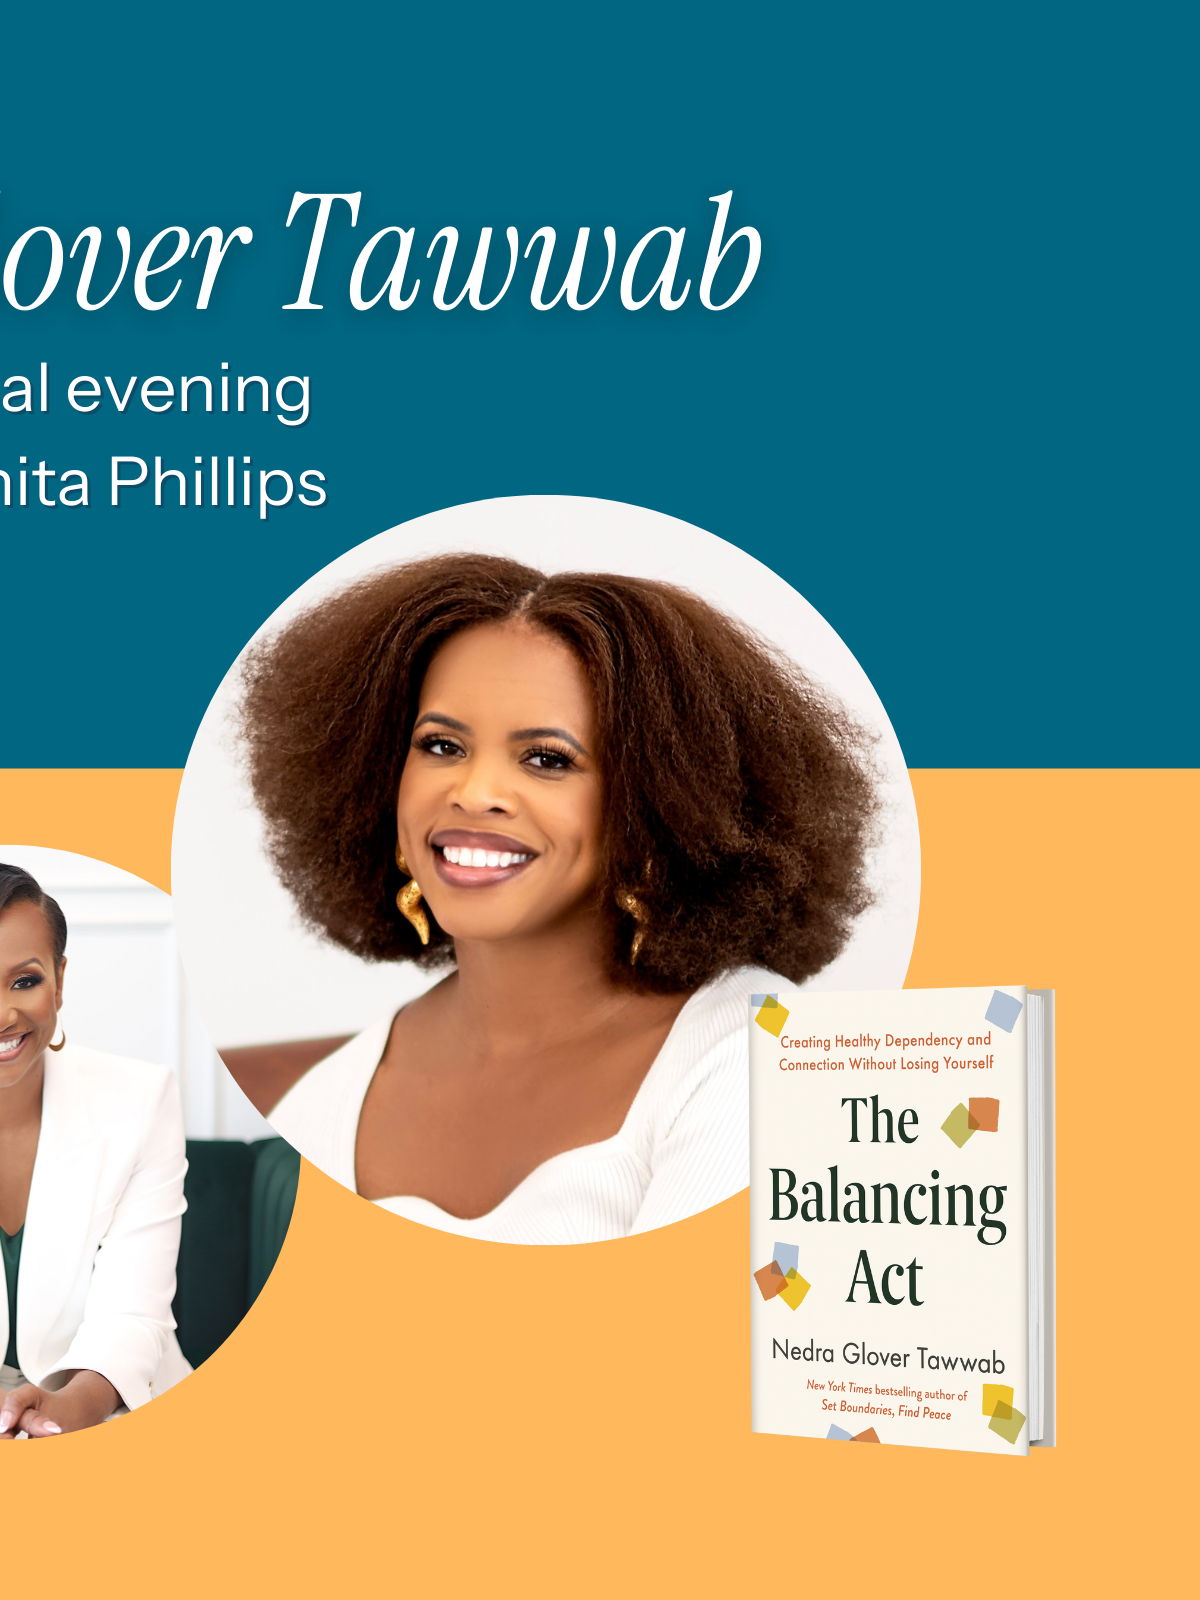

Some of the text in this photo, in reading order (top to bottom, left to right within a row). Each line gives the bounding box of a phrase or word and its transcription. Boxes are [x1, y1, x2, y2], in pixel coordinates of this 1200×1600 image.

[282, 190, 761, 310] Tawwab
[68, 363, 309, 425] evening
[112, 457, 326, 519] Phillips
[779, 1055, 993, 1073] Connection Without Losing Yourself
[781, 1031, 990, 1051] Creating Healthy Dependency and
[841, 1094, 918, 1143] The
[769, 1165, 1007, 1245] Balancing
[845, 1250, 924, 1306] Act
[773, 1338, 1005, 1374] Nedra Glover Tawwab
[807, 1379, 968, 1402] New York Times bestselling author of
[822, 1399, 951, 1420] Set Boundaries, Find Peace
